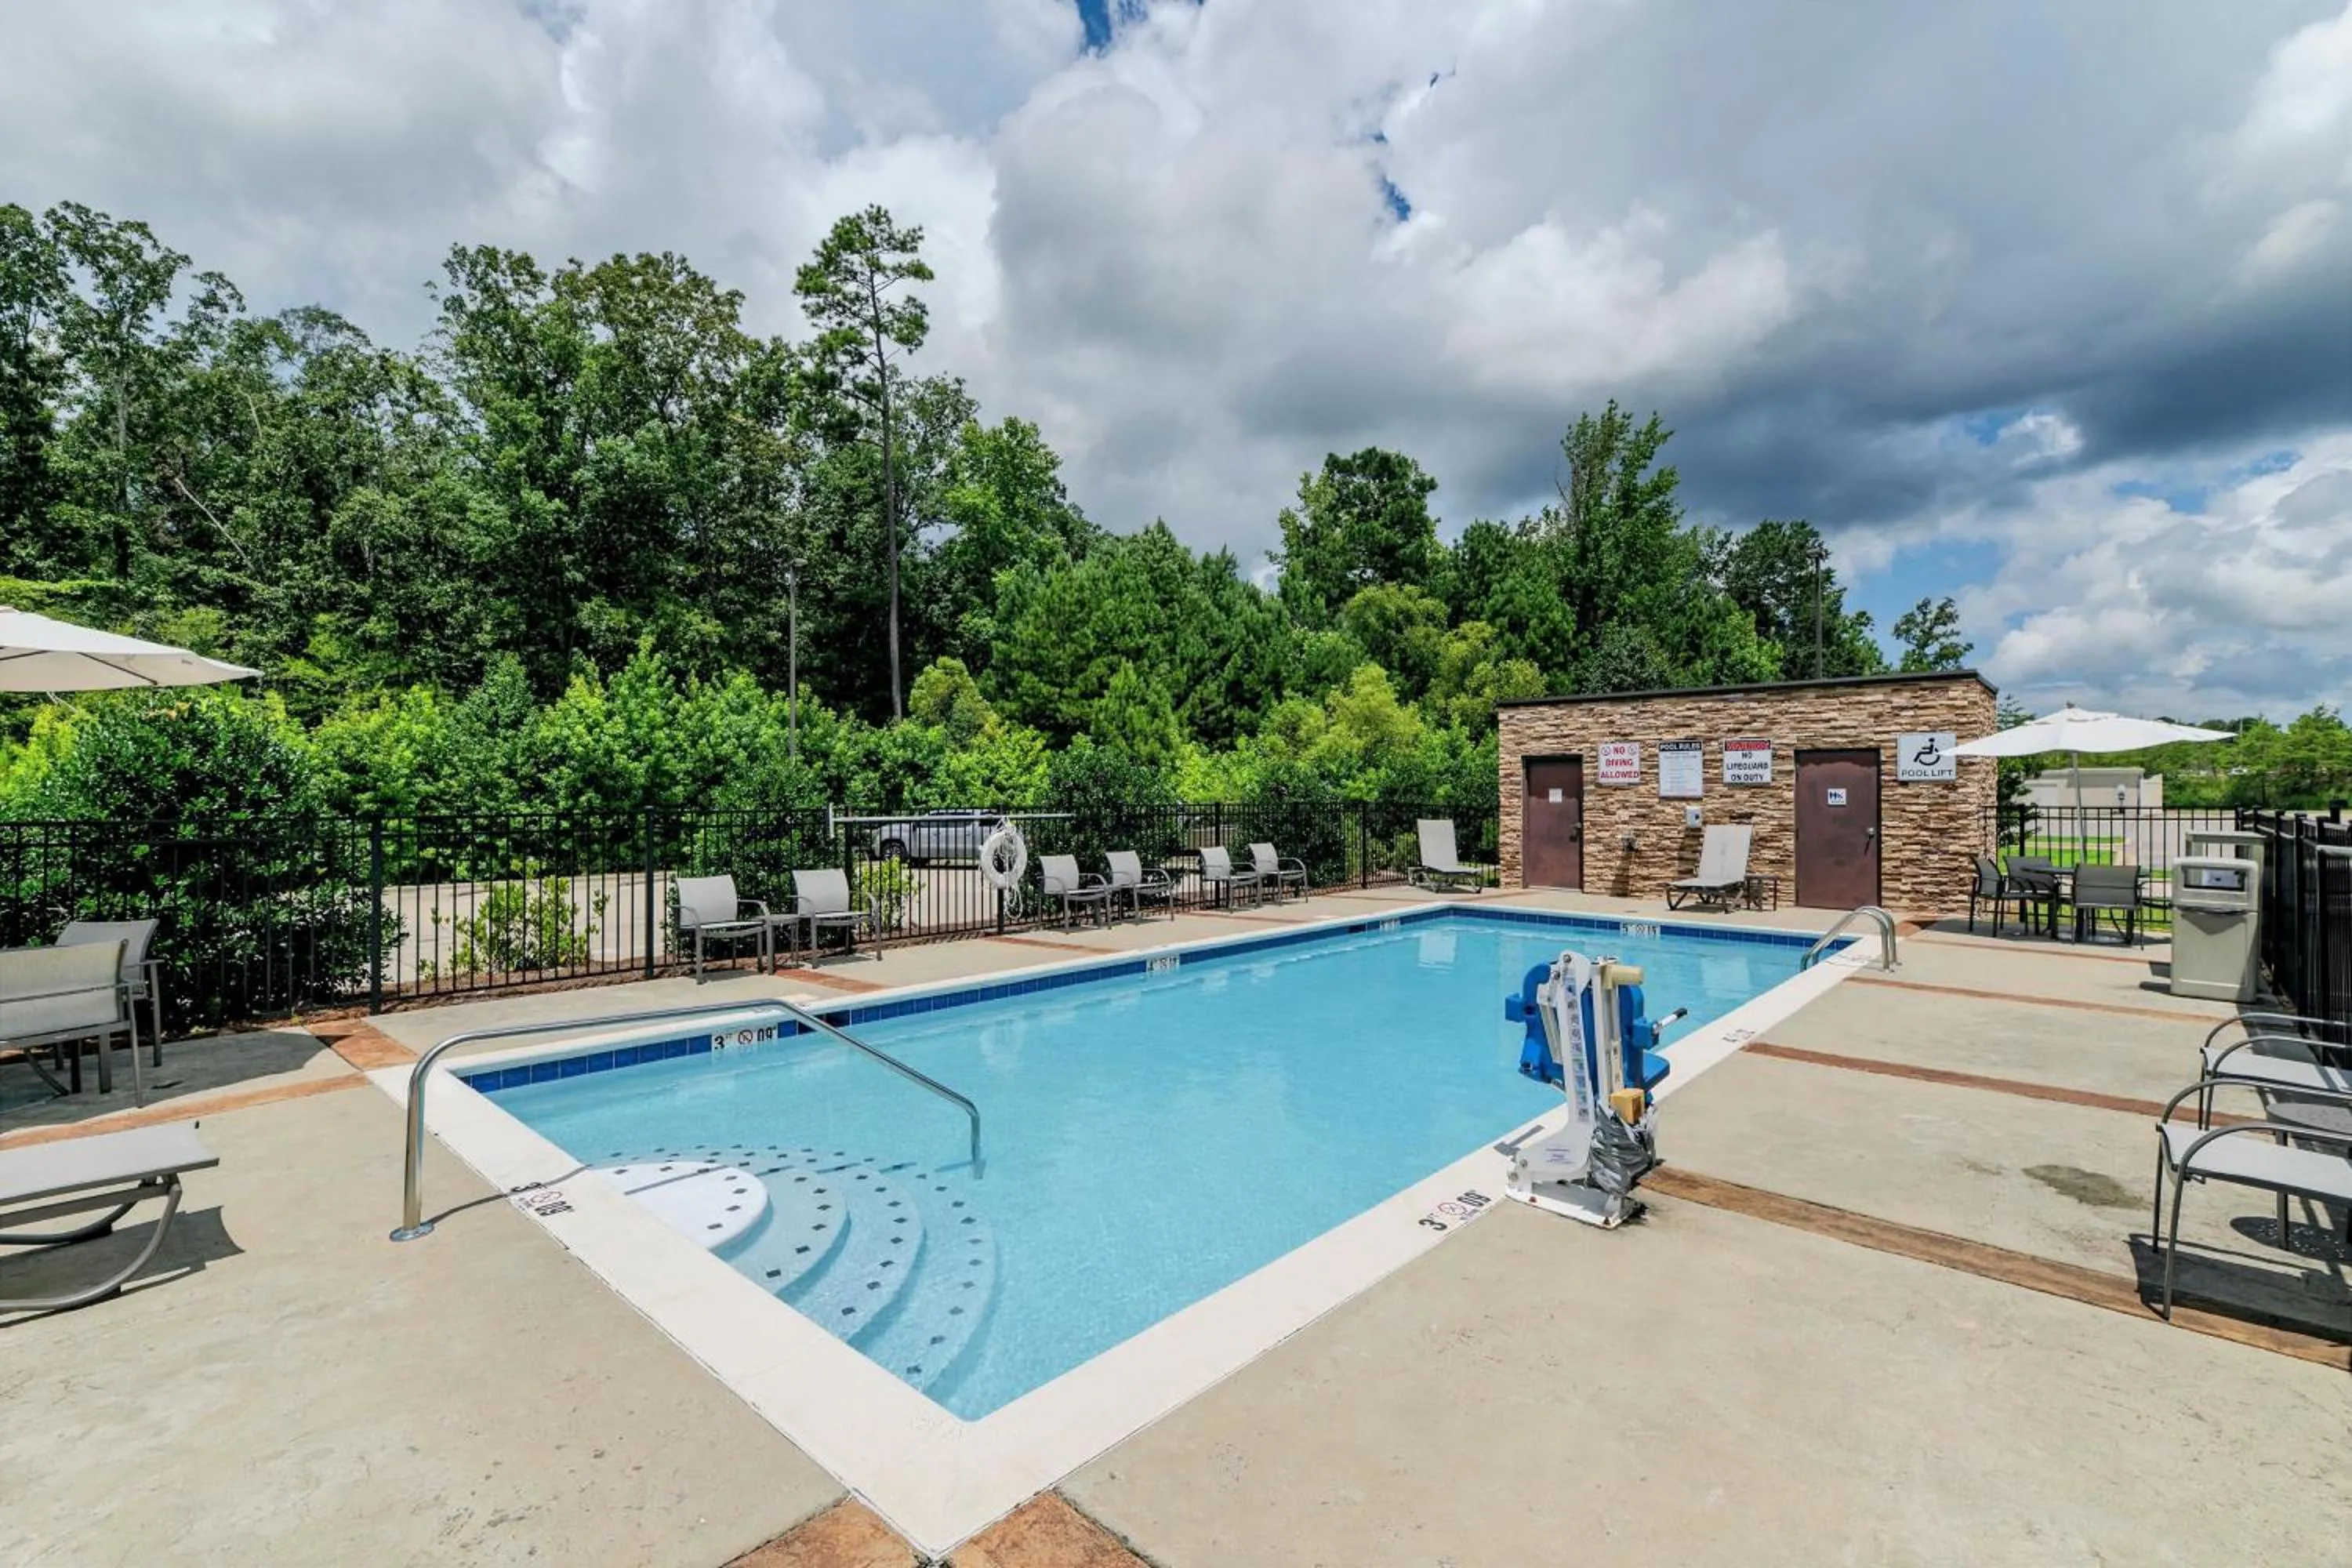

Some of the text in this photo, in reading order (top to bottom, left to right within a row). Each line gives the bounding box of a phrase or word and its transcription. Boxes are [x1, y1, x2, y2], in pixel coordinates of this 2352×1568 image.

[1613, 746, 1625, 754] NO
[1726, 762, 1769, 771] LIFEGUARD
[714, 1036, 725, 1050] 3
[1418, 1219, 1447, 1231] 3
